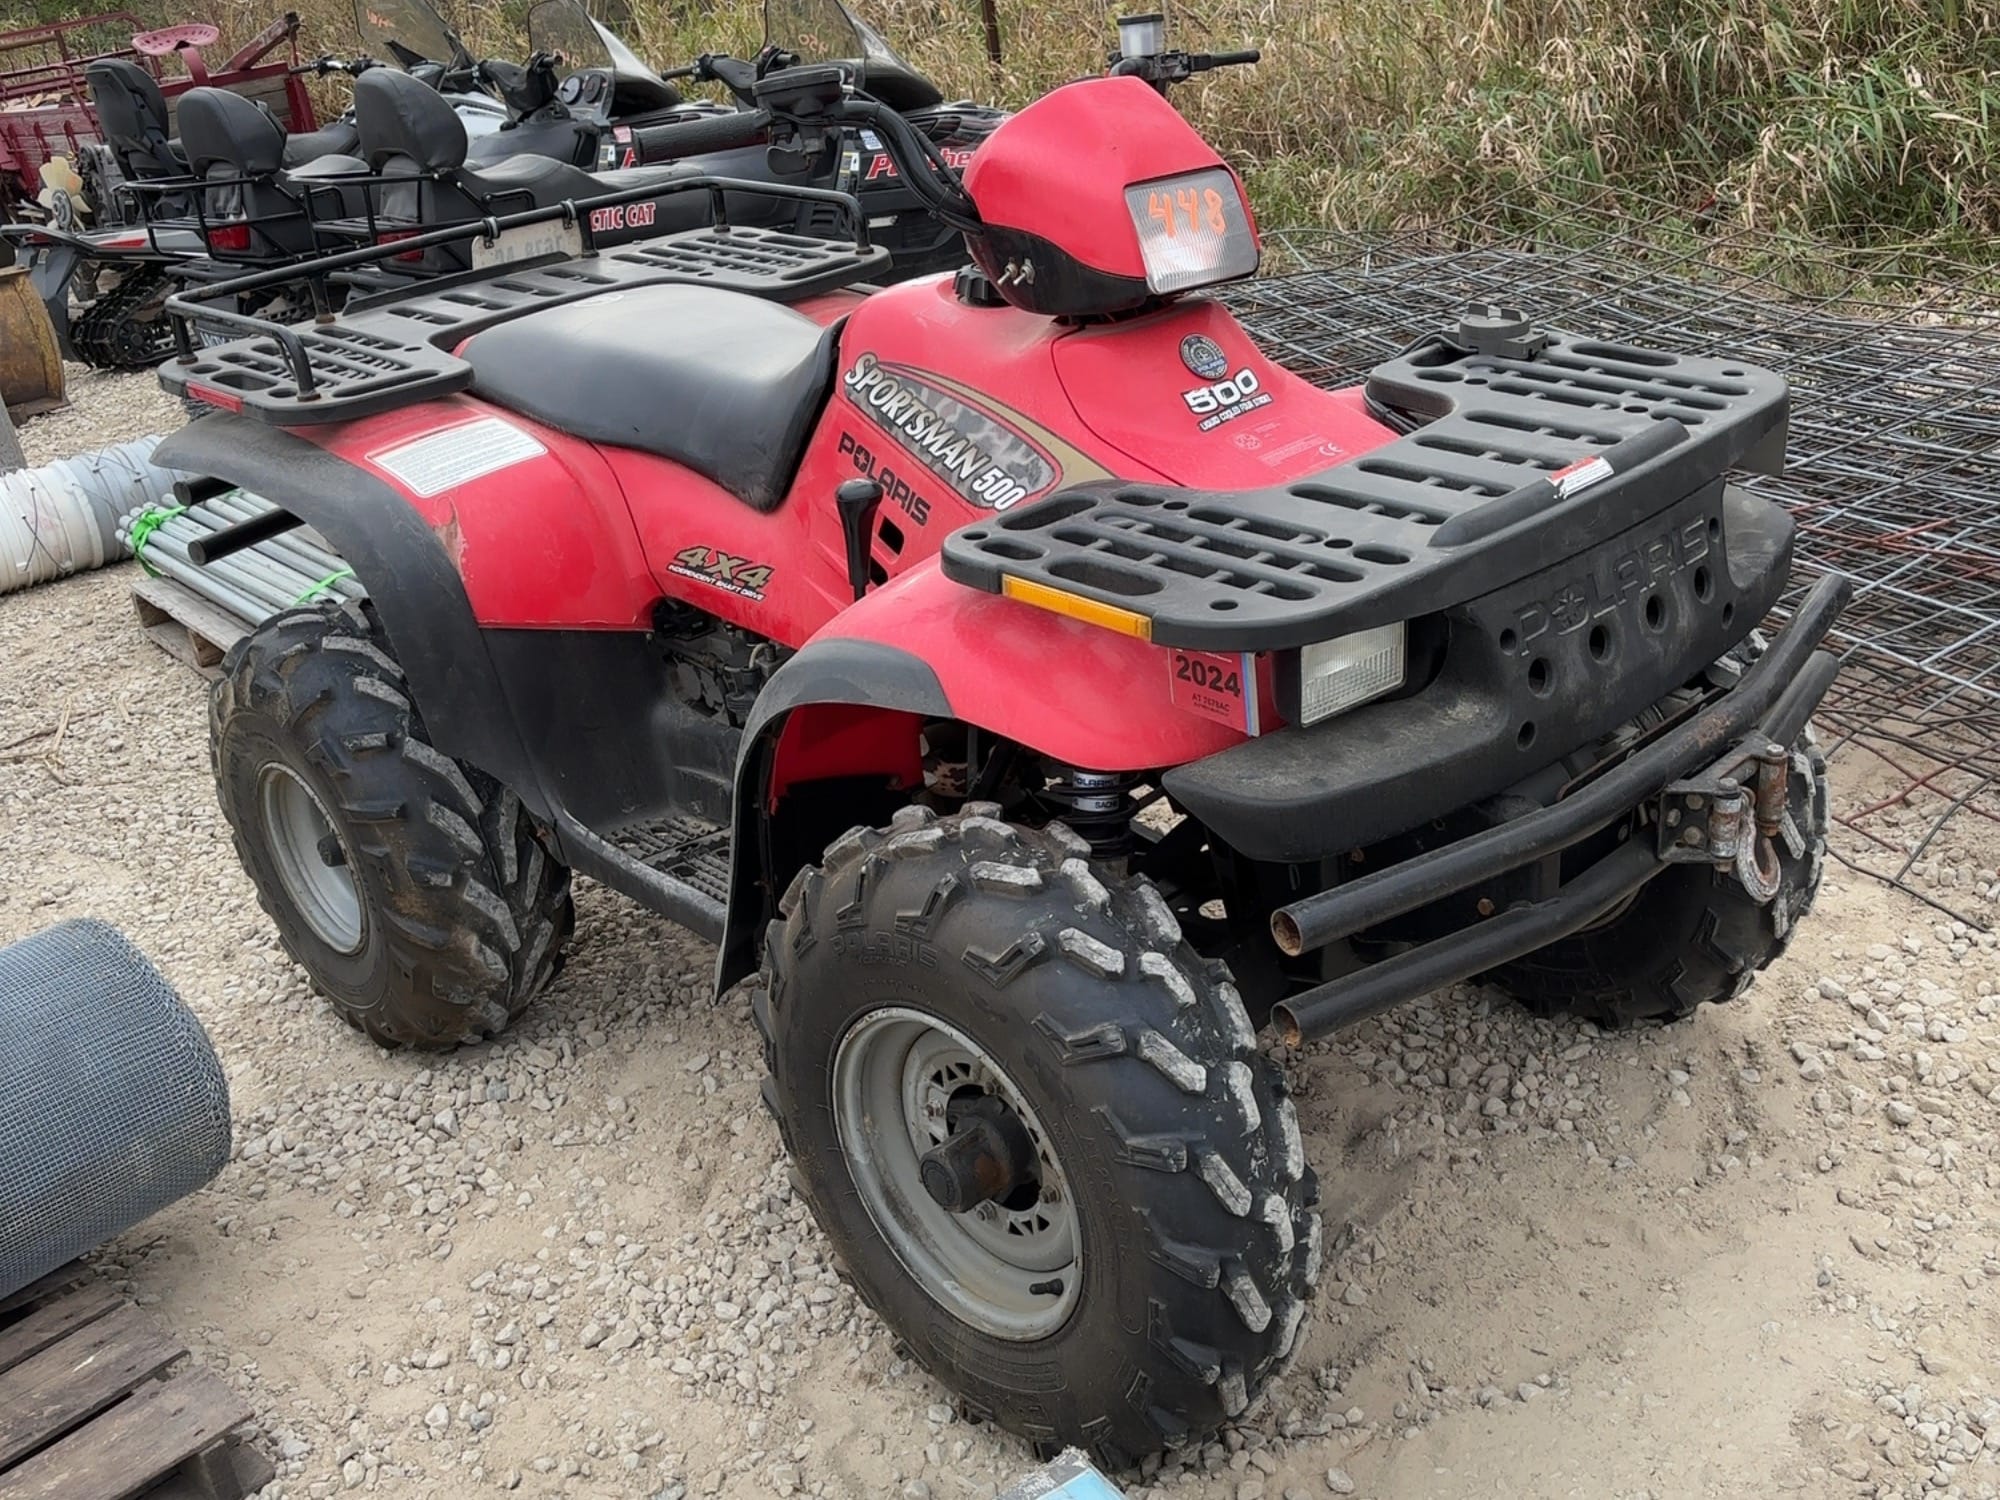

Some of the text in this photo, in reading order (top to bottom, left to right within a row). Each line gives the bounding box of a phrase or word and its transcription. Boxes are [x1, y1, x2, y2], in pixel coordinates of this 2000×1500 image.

[625, 202, 656, 227] CAT
[1148, 188, 1226, 239] 448
[1182, 367, 1259, 414] 500
[844, 352, 1027, 511] SPORTSMAN 500
[838, 431, 932, 527] POLARIS
[675, 546, 775, 588] 4X4
[1512, 513, 1710, 656] POLARIS
[1175, 654, 1240, 698] 2024
